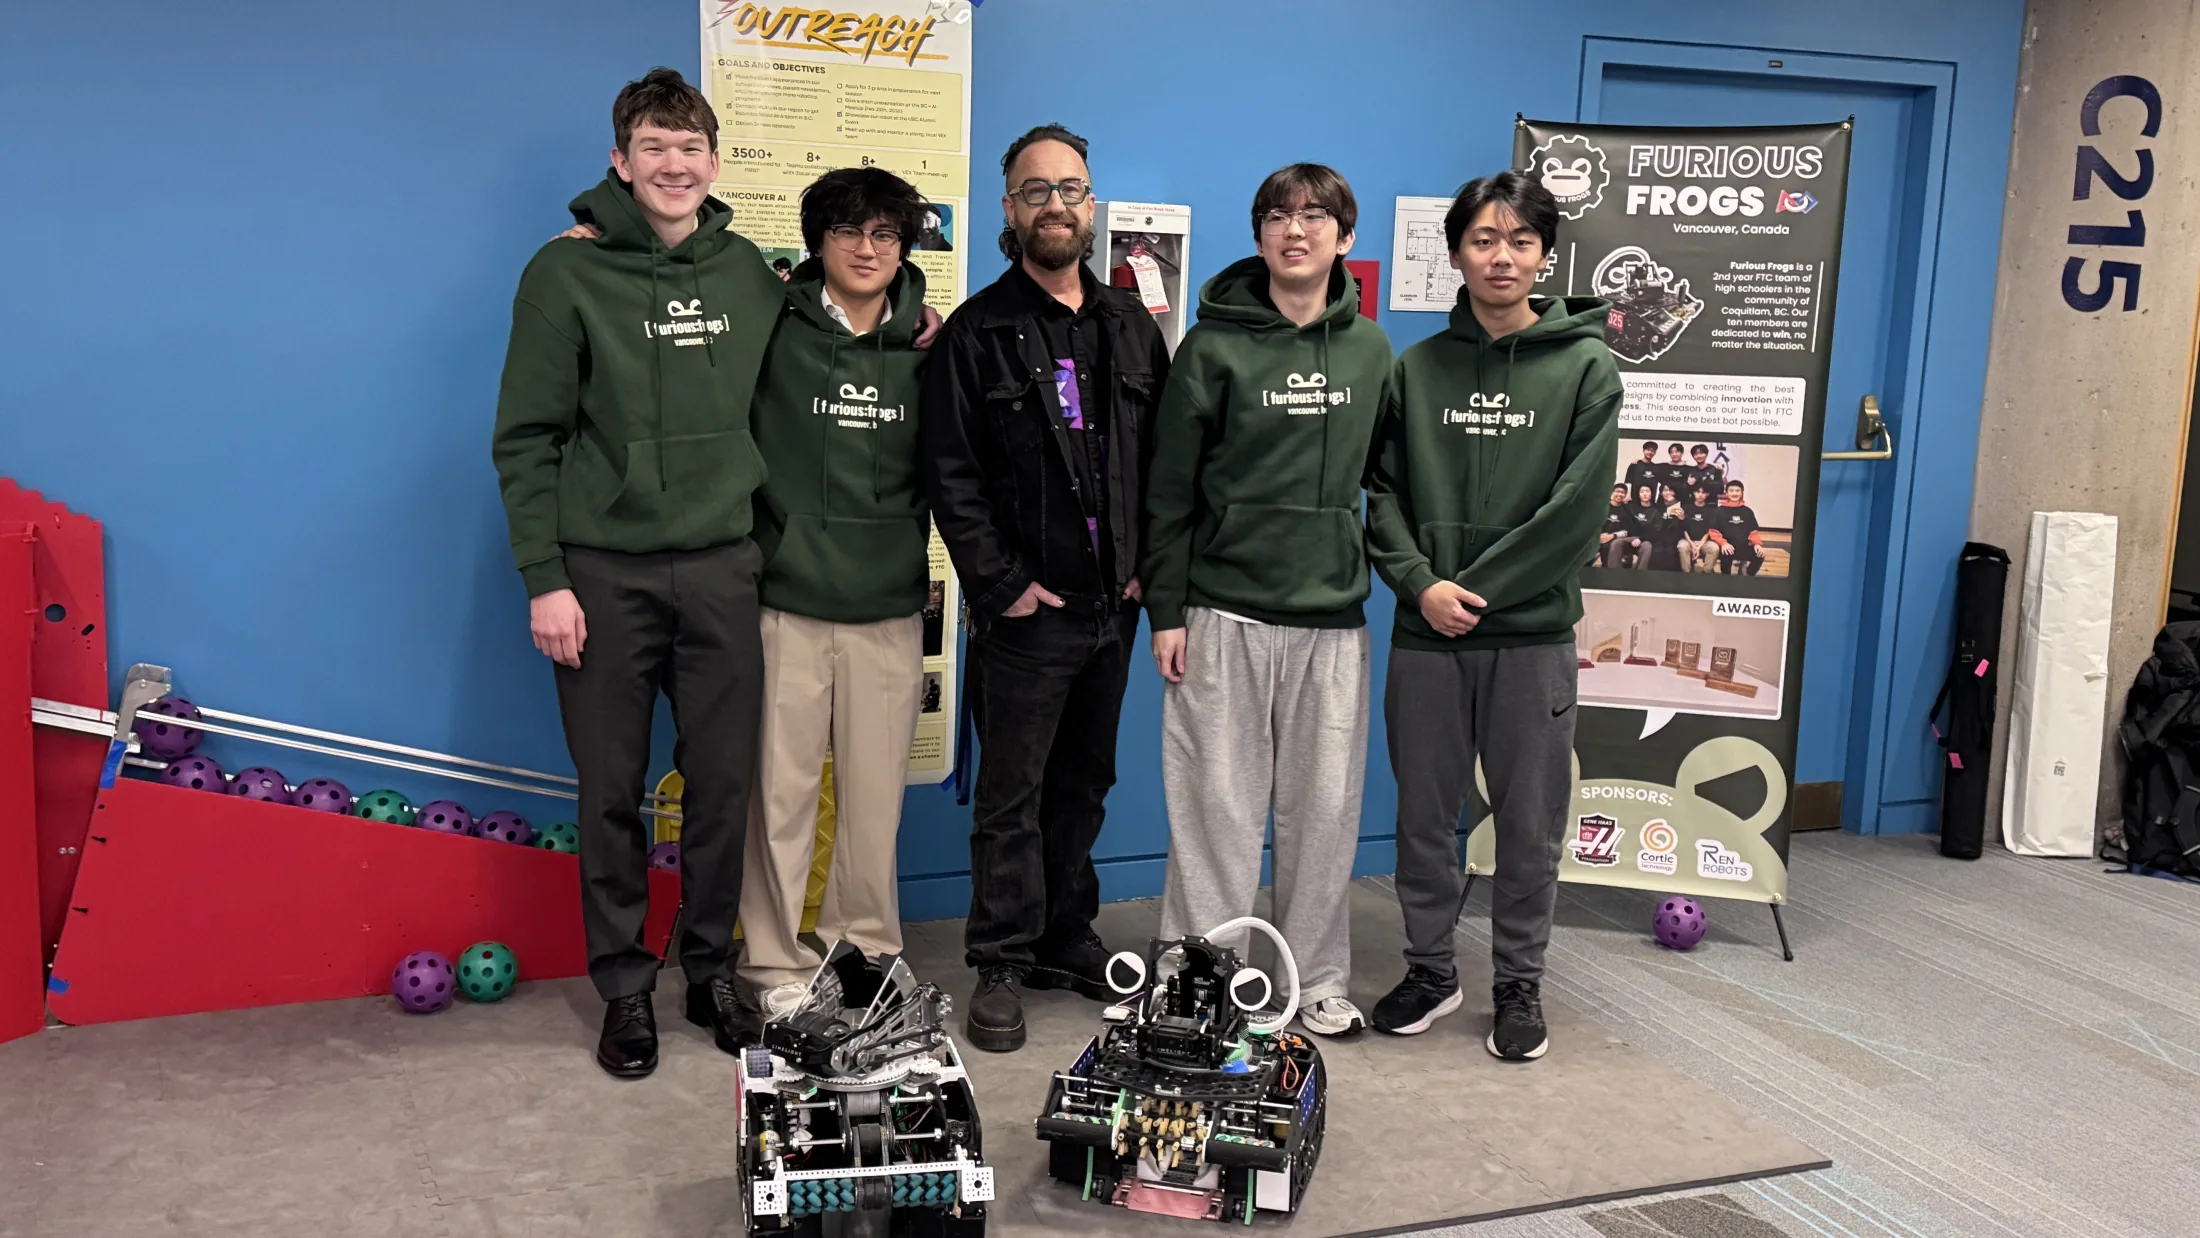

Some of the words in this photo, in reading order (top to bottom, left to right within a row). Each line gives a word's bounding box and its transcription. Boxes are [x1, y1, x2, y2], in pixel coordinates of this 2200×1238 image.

[733, 2, 936, 67] OUTREACH
[718, 59, 749, 68] GOALS
[751, 61, 770, 69] AND
[773, 63, 825, 74] OBJECTIVES
[732, 147, 772, 159] 3500+
[806, 152, 820, 162] 8+
[862, 156, 875, 165] 8+
[922, 160, 927, 169] 1
[1628, 145, 1823, 179] FURIOUS
[719, 191, 775, 201] VANCOUVER
[1568, 190, 1591, 203] FROGS
[2061, 75, 2162, 312] C215
[1626, 185, 1764, 216] FROGS
[1673, 223, 1740, 235] Vancouver,
[1741, 224, 1790, 235] Canada
[1730, 261, 1765, 270] Furious
[1768, 262, 1794, 272] Frogs
[1733, 274, 1753, 282] year
[1802, 274, 1812, 282] of
[1715, 284, 1735, 294] high
[1738, 284, 1782, 293] schoolers
[1745, 297, 1798, 307] community
[1800, 297, 1810, 305] of
[1722, 307, 1772, 316] Coquitlam,
[1712, 329, 1759, 338] dedicated
[1773, 330, 1792, 339] win,
[1763, 342, 1805, 350] situation.
[1626, 381, 1676, 389] committed
[1703, 383, 1741, 393] creating
[1657, 393, 1666, 401] by
[1670, 394, 1718, 403] combining
[1721, 395, 1772, 403] innovation
[1288, 406, 1320, 415] vancouver,
[838, 420, 872, 429] vancouver,
[1740, 418, 1780, 427] possible.
[1717, 603, 1785, 616] AWARDS:
[1581, 786, 1673, 806] SPONSORS:
[1641, 853, 1674, 863] Cortic
[1701, 844, 1734, 865] REN
[1703, 864, 1747, 876] ROBOTS
